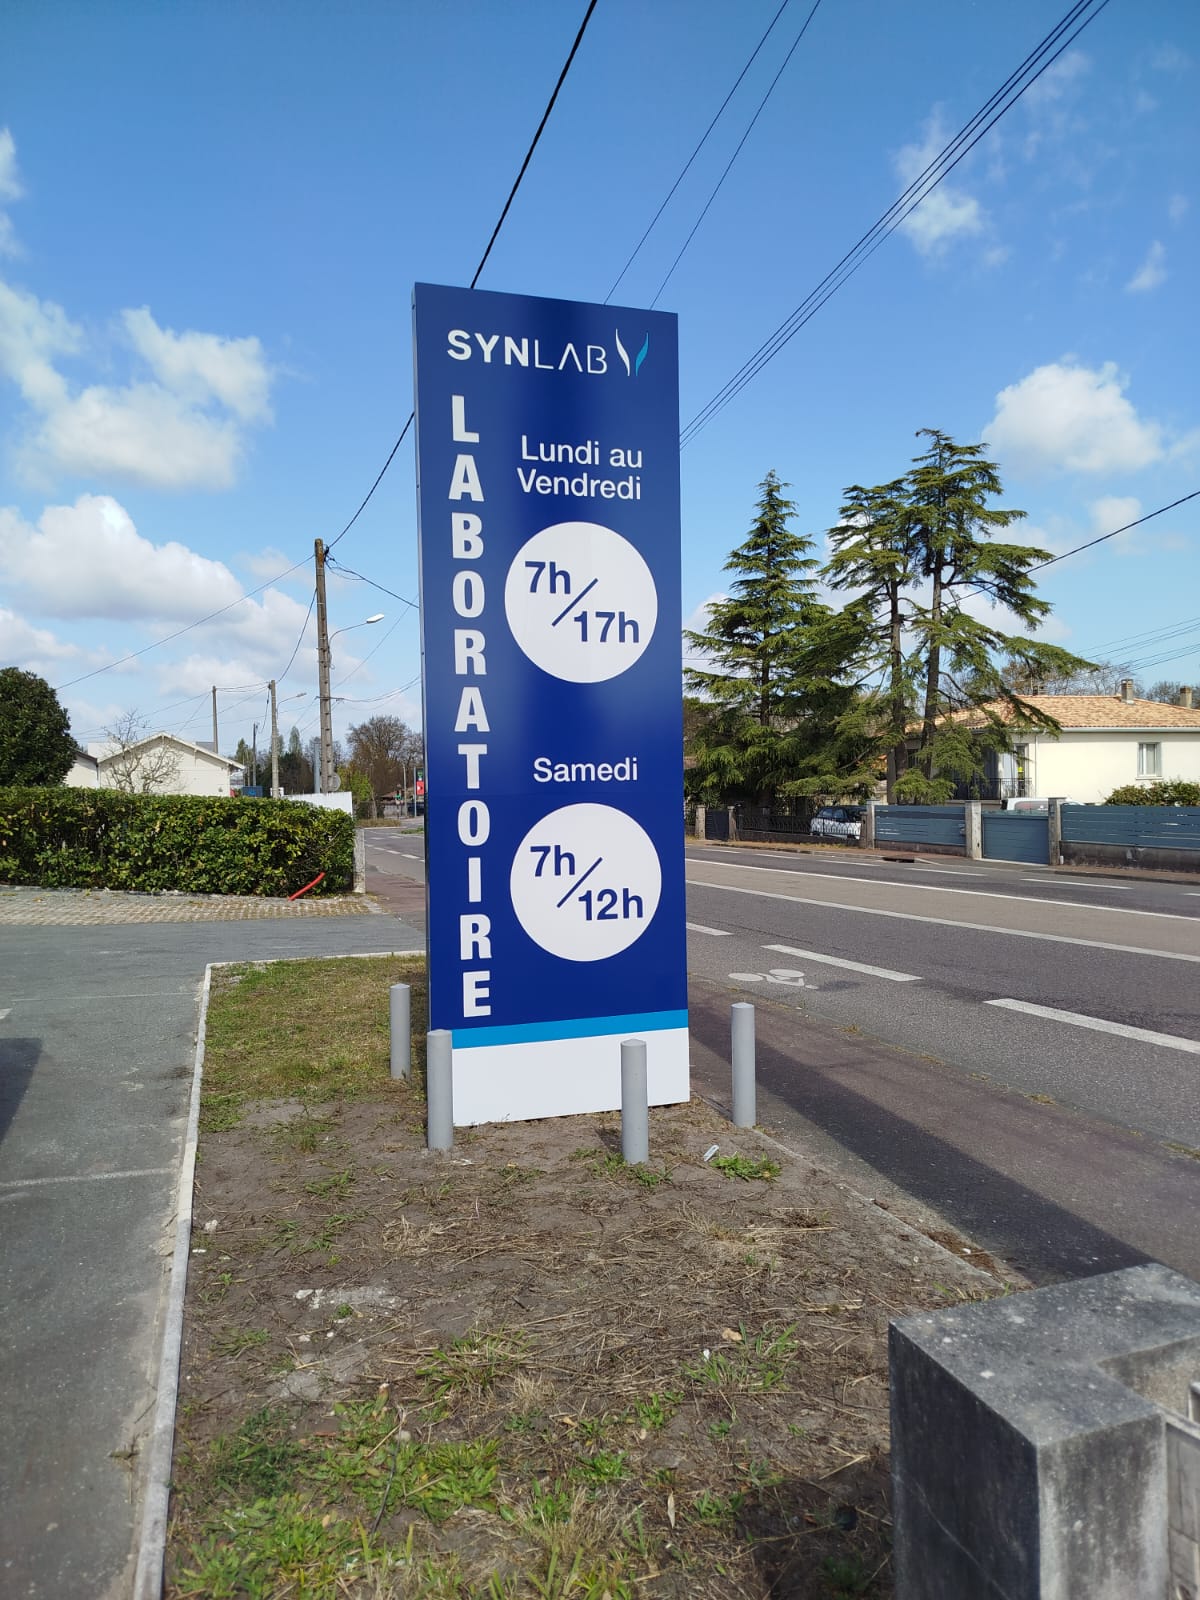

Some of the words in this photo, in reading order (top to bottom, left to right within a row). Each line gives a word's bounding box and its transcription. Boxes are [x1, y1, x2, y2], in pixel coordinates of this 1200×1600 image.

[447, 329, 608, 375] SYNLAB
[521, 435, 600, 467] Lundi
[609, 447, 642, 469] au
[517, 468, 642, 500] Vendredi
[447, 395, 492, 1018] LABORATOIRE
[533, 757, 638, 783] Samedi
